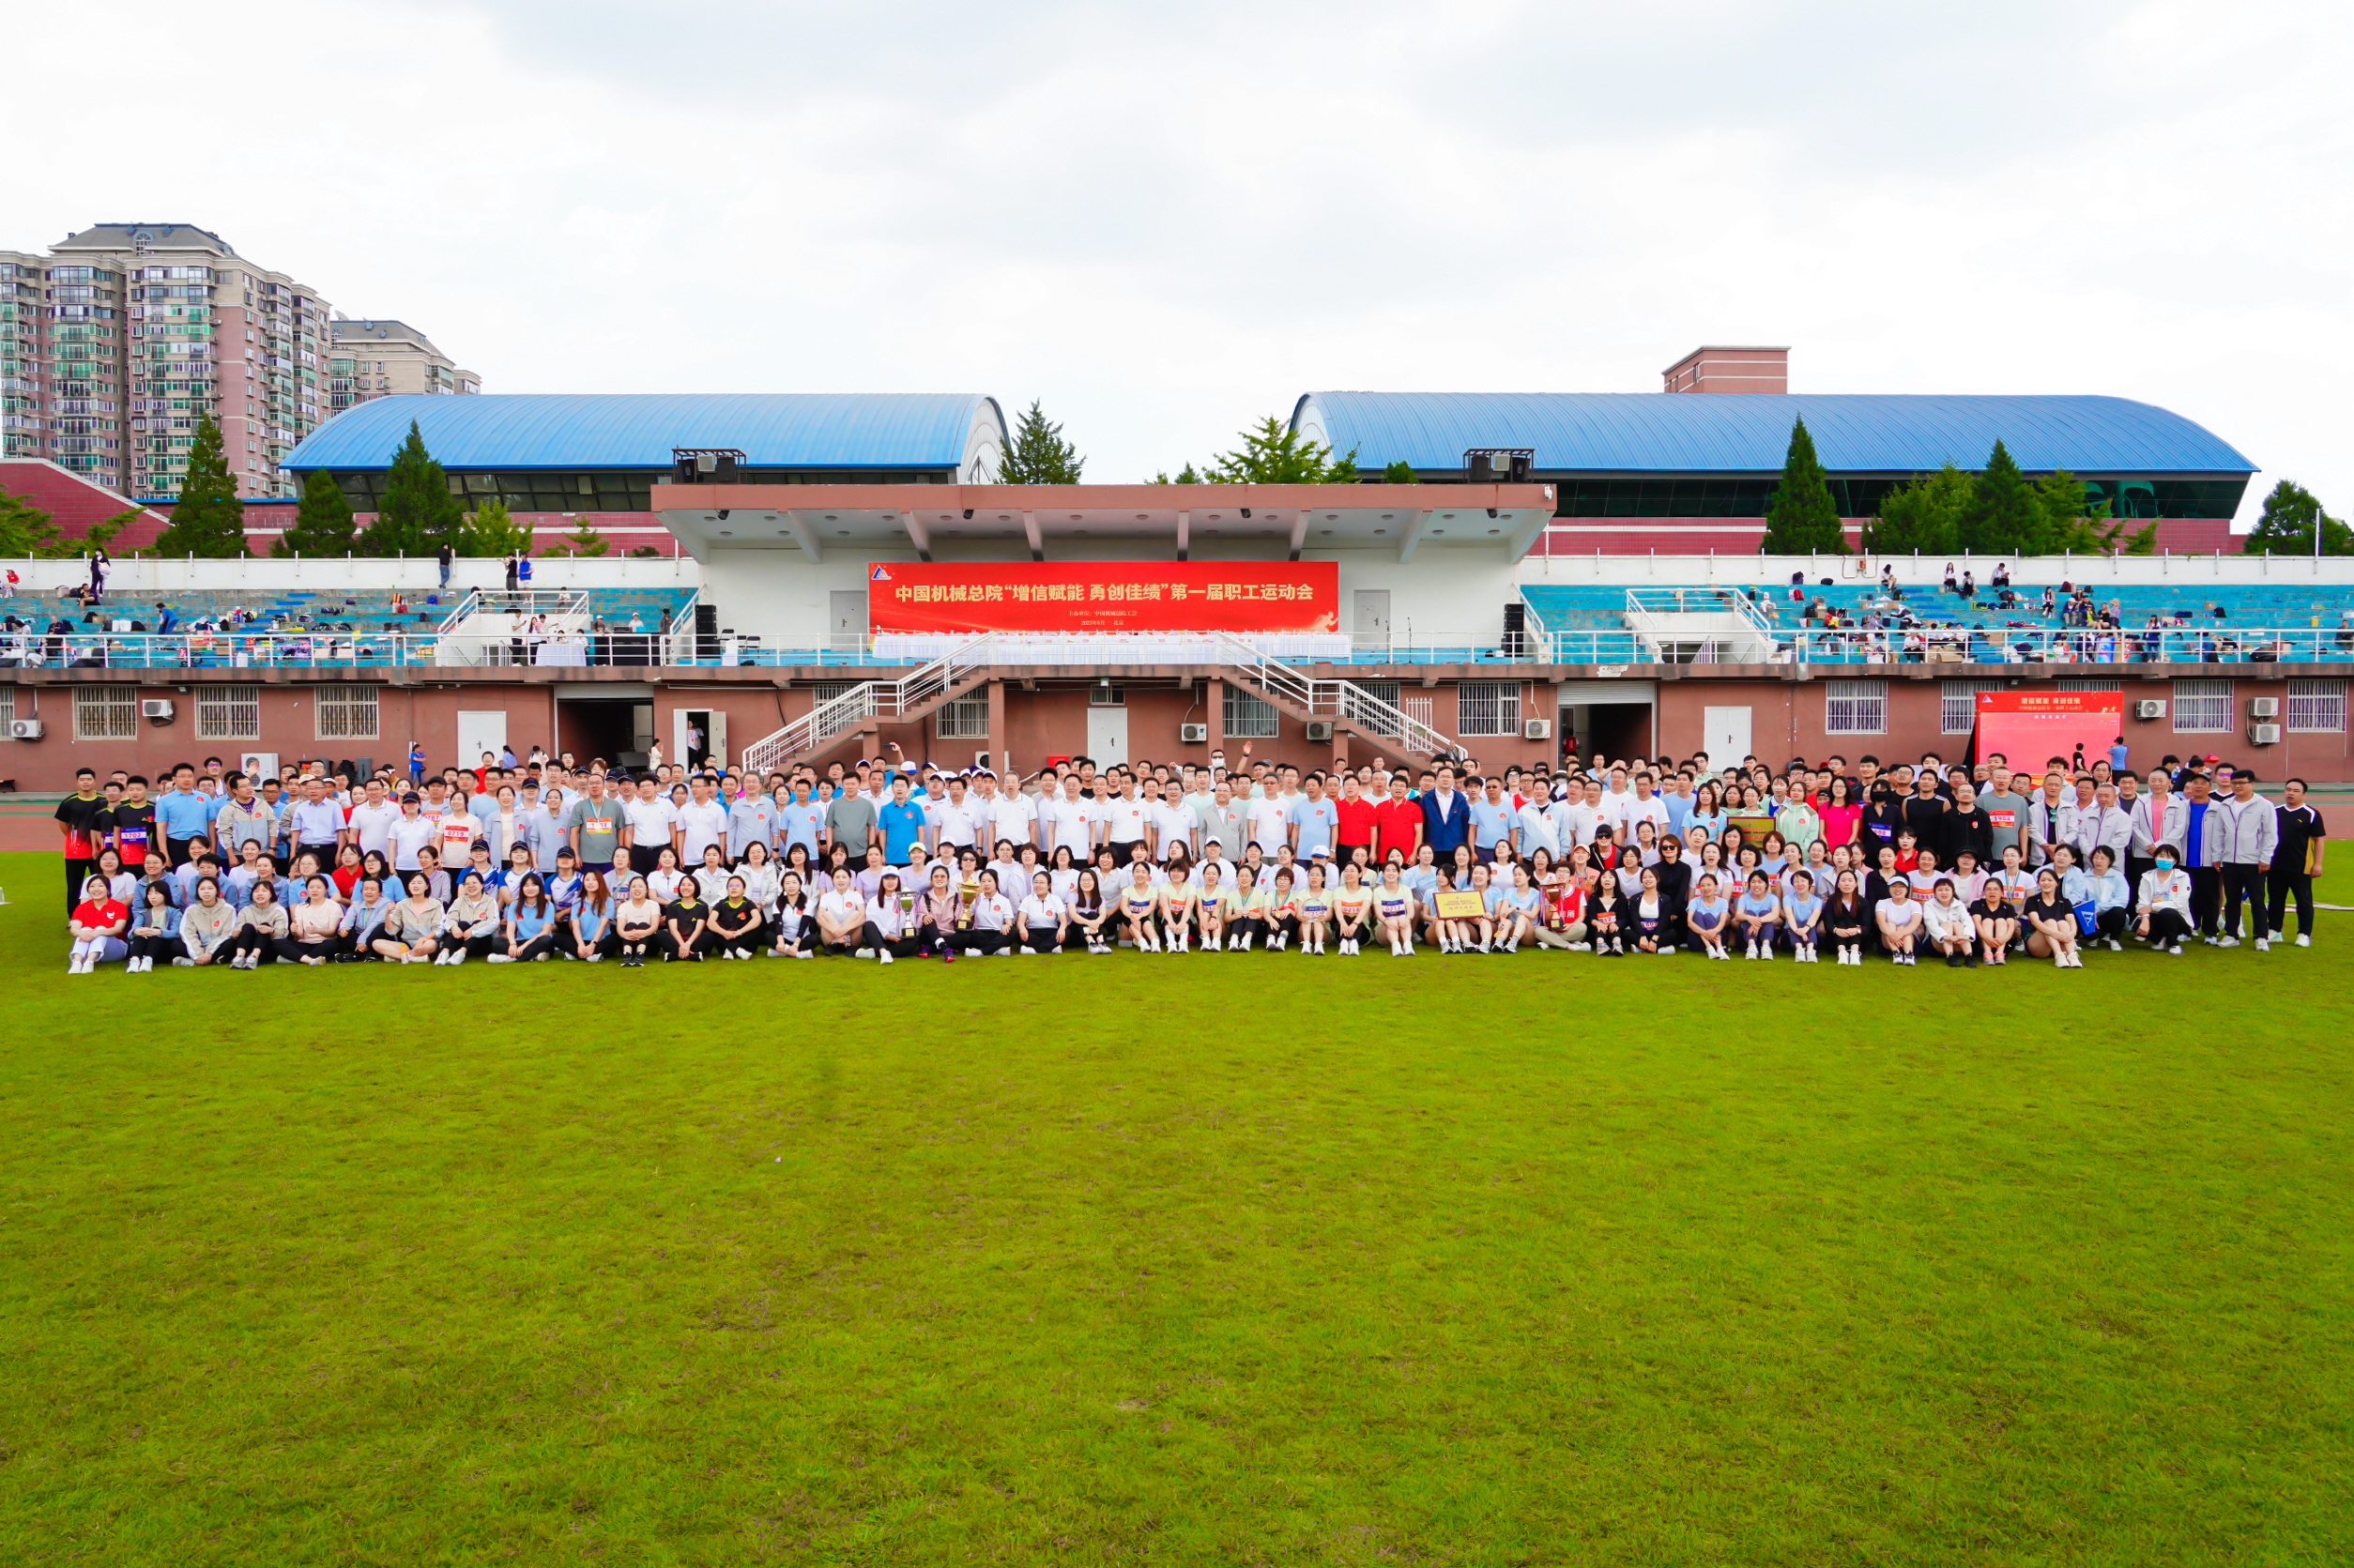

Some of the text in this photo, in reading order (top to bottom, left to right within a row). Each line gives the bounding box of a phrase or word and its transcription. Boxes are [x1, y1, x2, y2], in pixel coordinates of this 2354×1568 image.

[895, 583, 1314, 602] 中国机械总院“增信赋能 勇创佳绩”第一届职工运动会
